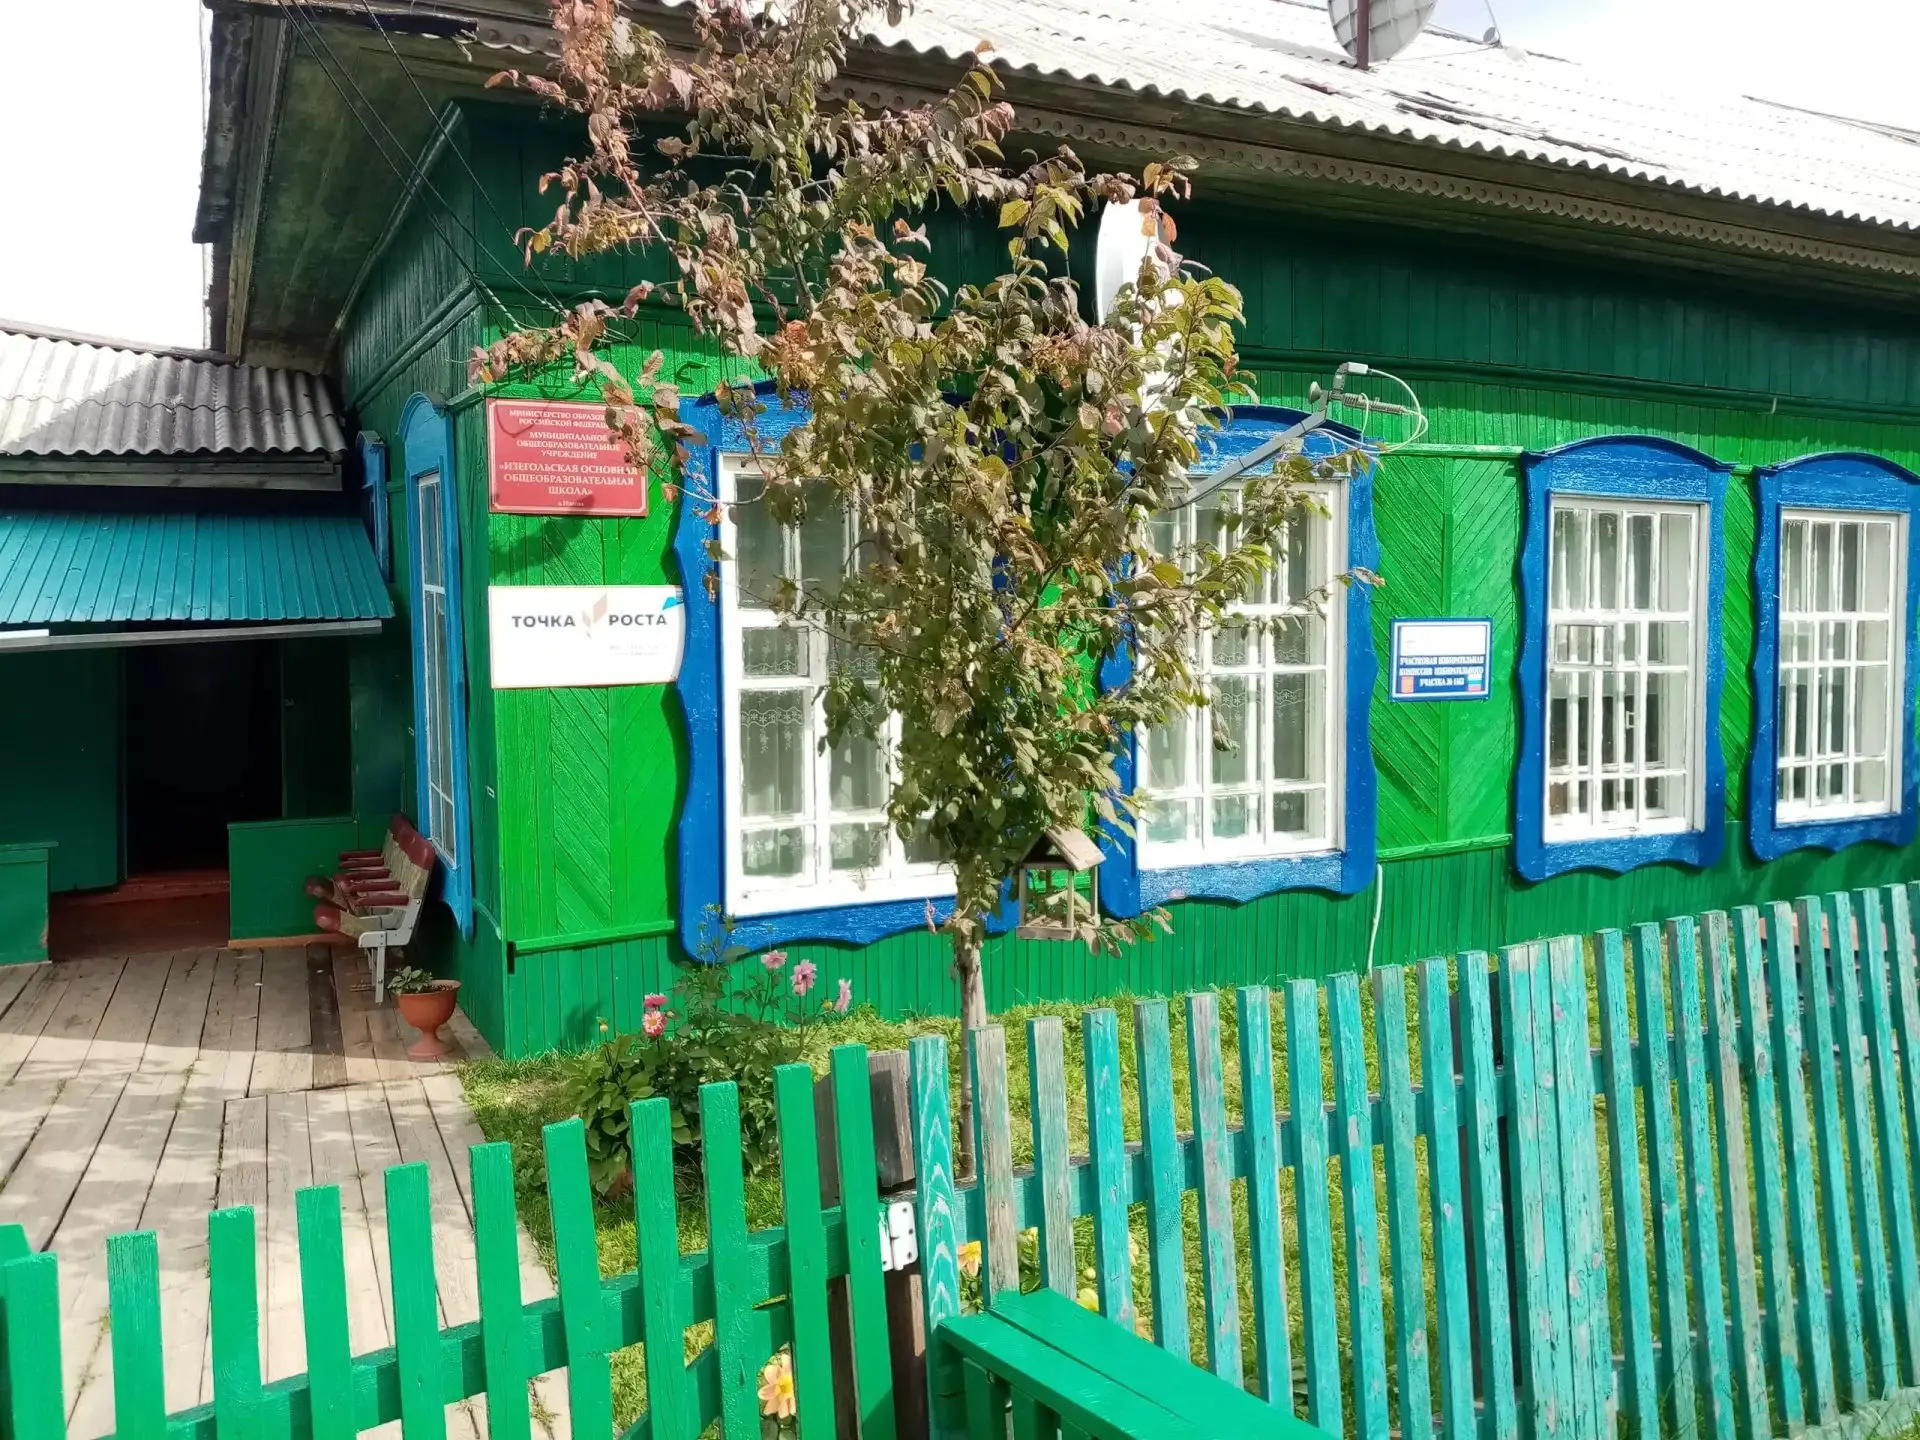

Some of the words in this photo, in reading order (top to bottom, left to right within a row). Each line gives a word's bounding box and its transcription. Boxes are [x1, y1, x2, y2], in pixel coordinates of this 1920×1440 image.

[509, 409, 571, 419] МИНИСТЕРСТВО
[572, 412, 606, 421] ОБРАЗОВ
[518, 418, 572, 427] РОССИЙСКОЙ
[572, 420, 609, 429] ФЕДЕРАЦ
[529, 431, 608, 442] МУНИЦИПАЛЬНОЕ
[516, 440, 621, 452] ОБЩЕОБРАЗОВАТЕЛЬНОЕ
[540, 450, 598, 459] УЧРЕЖДЕНИЕ
[580, 464, 638, 475] ОСНОВНАЯ
[503, 473, 635, 486] ОБЩЕОБРАЗОВАТЕЛЬНАЯ
[548, 486, 593, 496] ШКОЛА»
[511, 615, 576, 628] ТОЧКА
[608, 614, 667, 626] РОСТА
